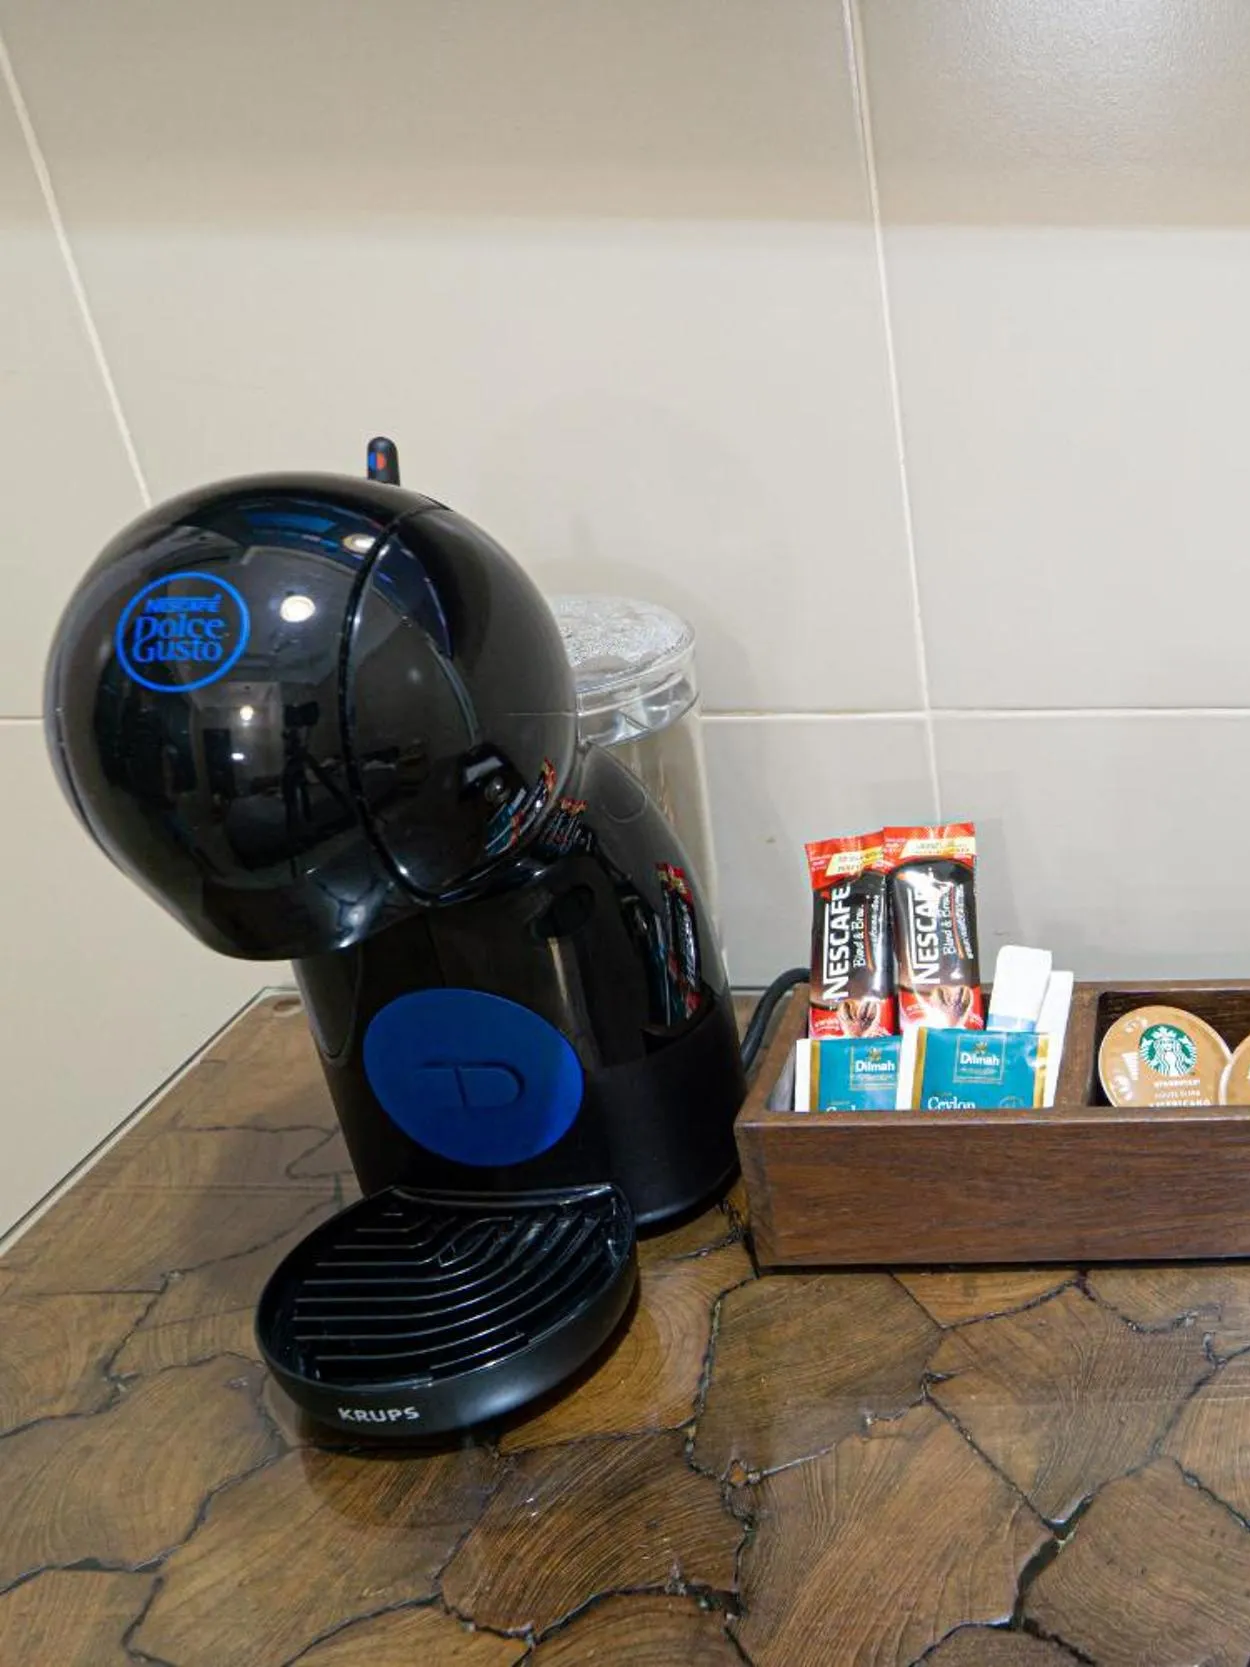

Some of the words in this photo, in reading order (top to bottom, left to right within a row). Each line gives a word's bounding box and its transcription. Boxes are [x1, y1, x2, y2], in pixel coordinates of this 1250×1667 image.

[908, 876, 941, 984] NESCA
[855, 1060, 896, 1073] Dilmah
[960, 1051, 1000, 1067] Dilmah
[338, 1406, 420, 1422] KRUPS
